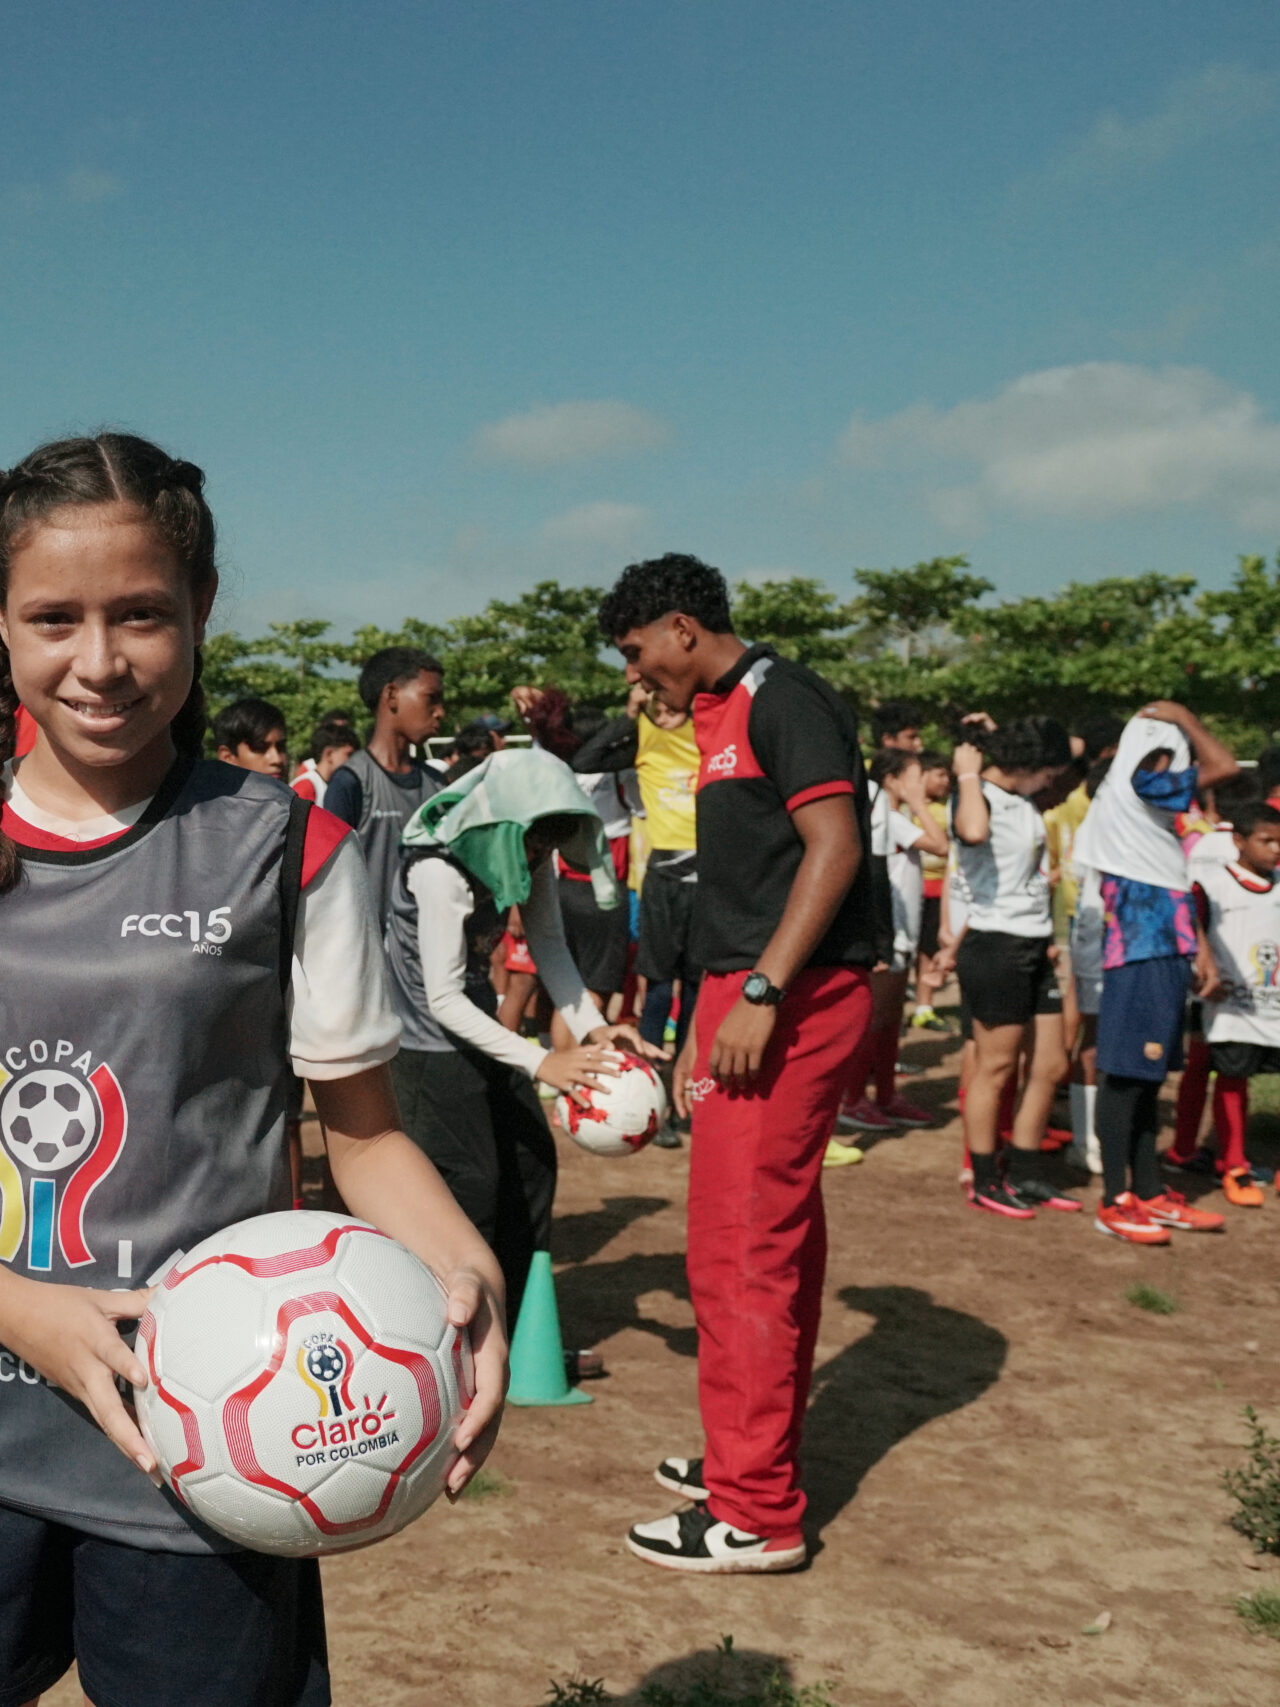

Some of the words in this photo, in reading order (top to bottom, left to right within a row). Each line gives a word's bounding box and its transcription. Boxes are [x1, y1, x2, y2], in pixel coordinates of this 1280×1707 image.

[120, 906, 233, 944] FCC15
[192, 942, 223, 956] AÑOS
[5, 1039, 92, 1076] COPA
[303, 1333, 334, 1349] COPA
[291, 1411, 384, 1450] Claro
[296, 1452, 327, 1467] POR
[329, 1431, 400, 1462] COLOMBIA
